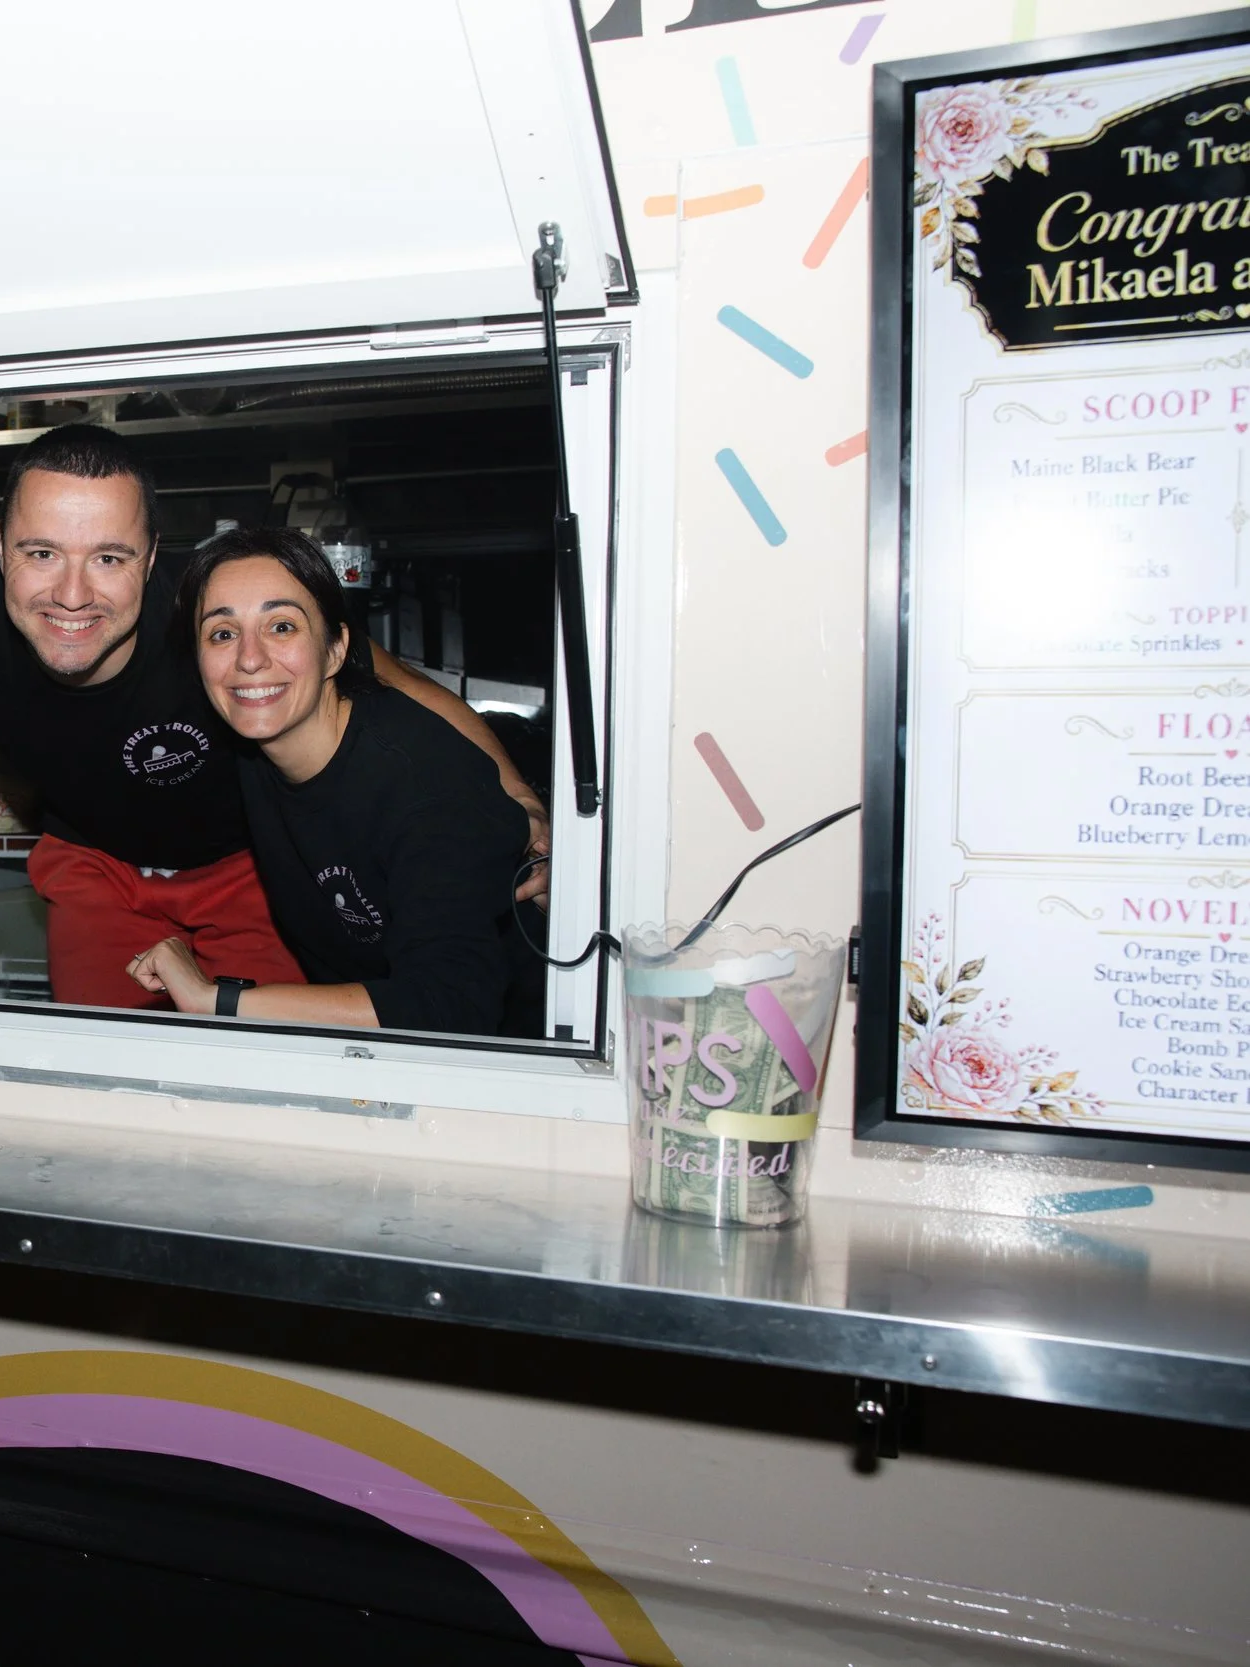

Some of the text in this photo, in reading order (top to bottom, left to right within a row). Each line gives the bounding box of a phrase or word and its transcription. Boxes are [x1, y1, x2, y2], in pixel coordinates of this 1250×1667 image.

[1121, 145, 1180, 176] The
[1025, 248, 1218, 309] Mikaela
[1083, 388, 1210, 423] SCOOP
[1011, 452, 1196, 478] Maine Black Bear
[1158, 486, 1191, 506] Pie
[1130, 632, 1222, 656] Sprinkles
[122, 722, 210, 775] THE TREAT TROLLEY
[145, 759, 206, 786] ICE CREAM
[1138, 765, 1194, 787] Root
[1109, 794, 1194, 822] Orange
[1078, 822, 1188, 850] Blueberry
[1124, 940, 1201, 967] Orange
[1093, 962, 1202, 990] Strawberry
[1114, 987, 1218, 1011] Chocolate
[1118, 1011, 1147, 1030] Ice
[1153, 1012, 1222, 1033] Cream
[1167, 1036, 1228, 1058] Bomb
[1131, 1056, 1203, 1078] Cookie
[1137, 1079, 1238, 1103] Character
